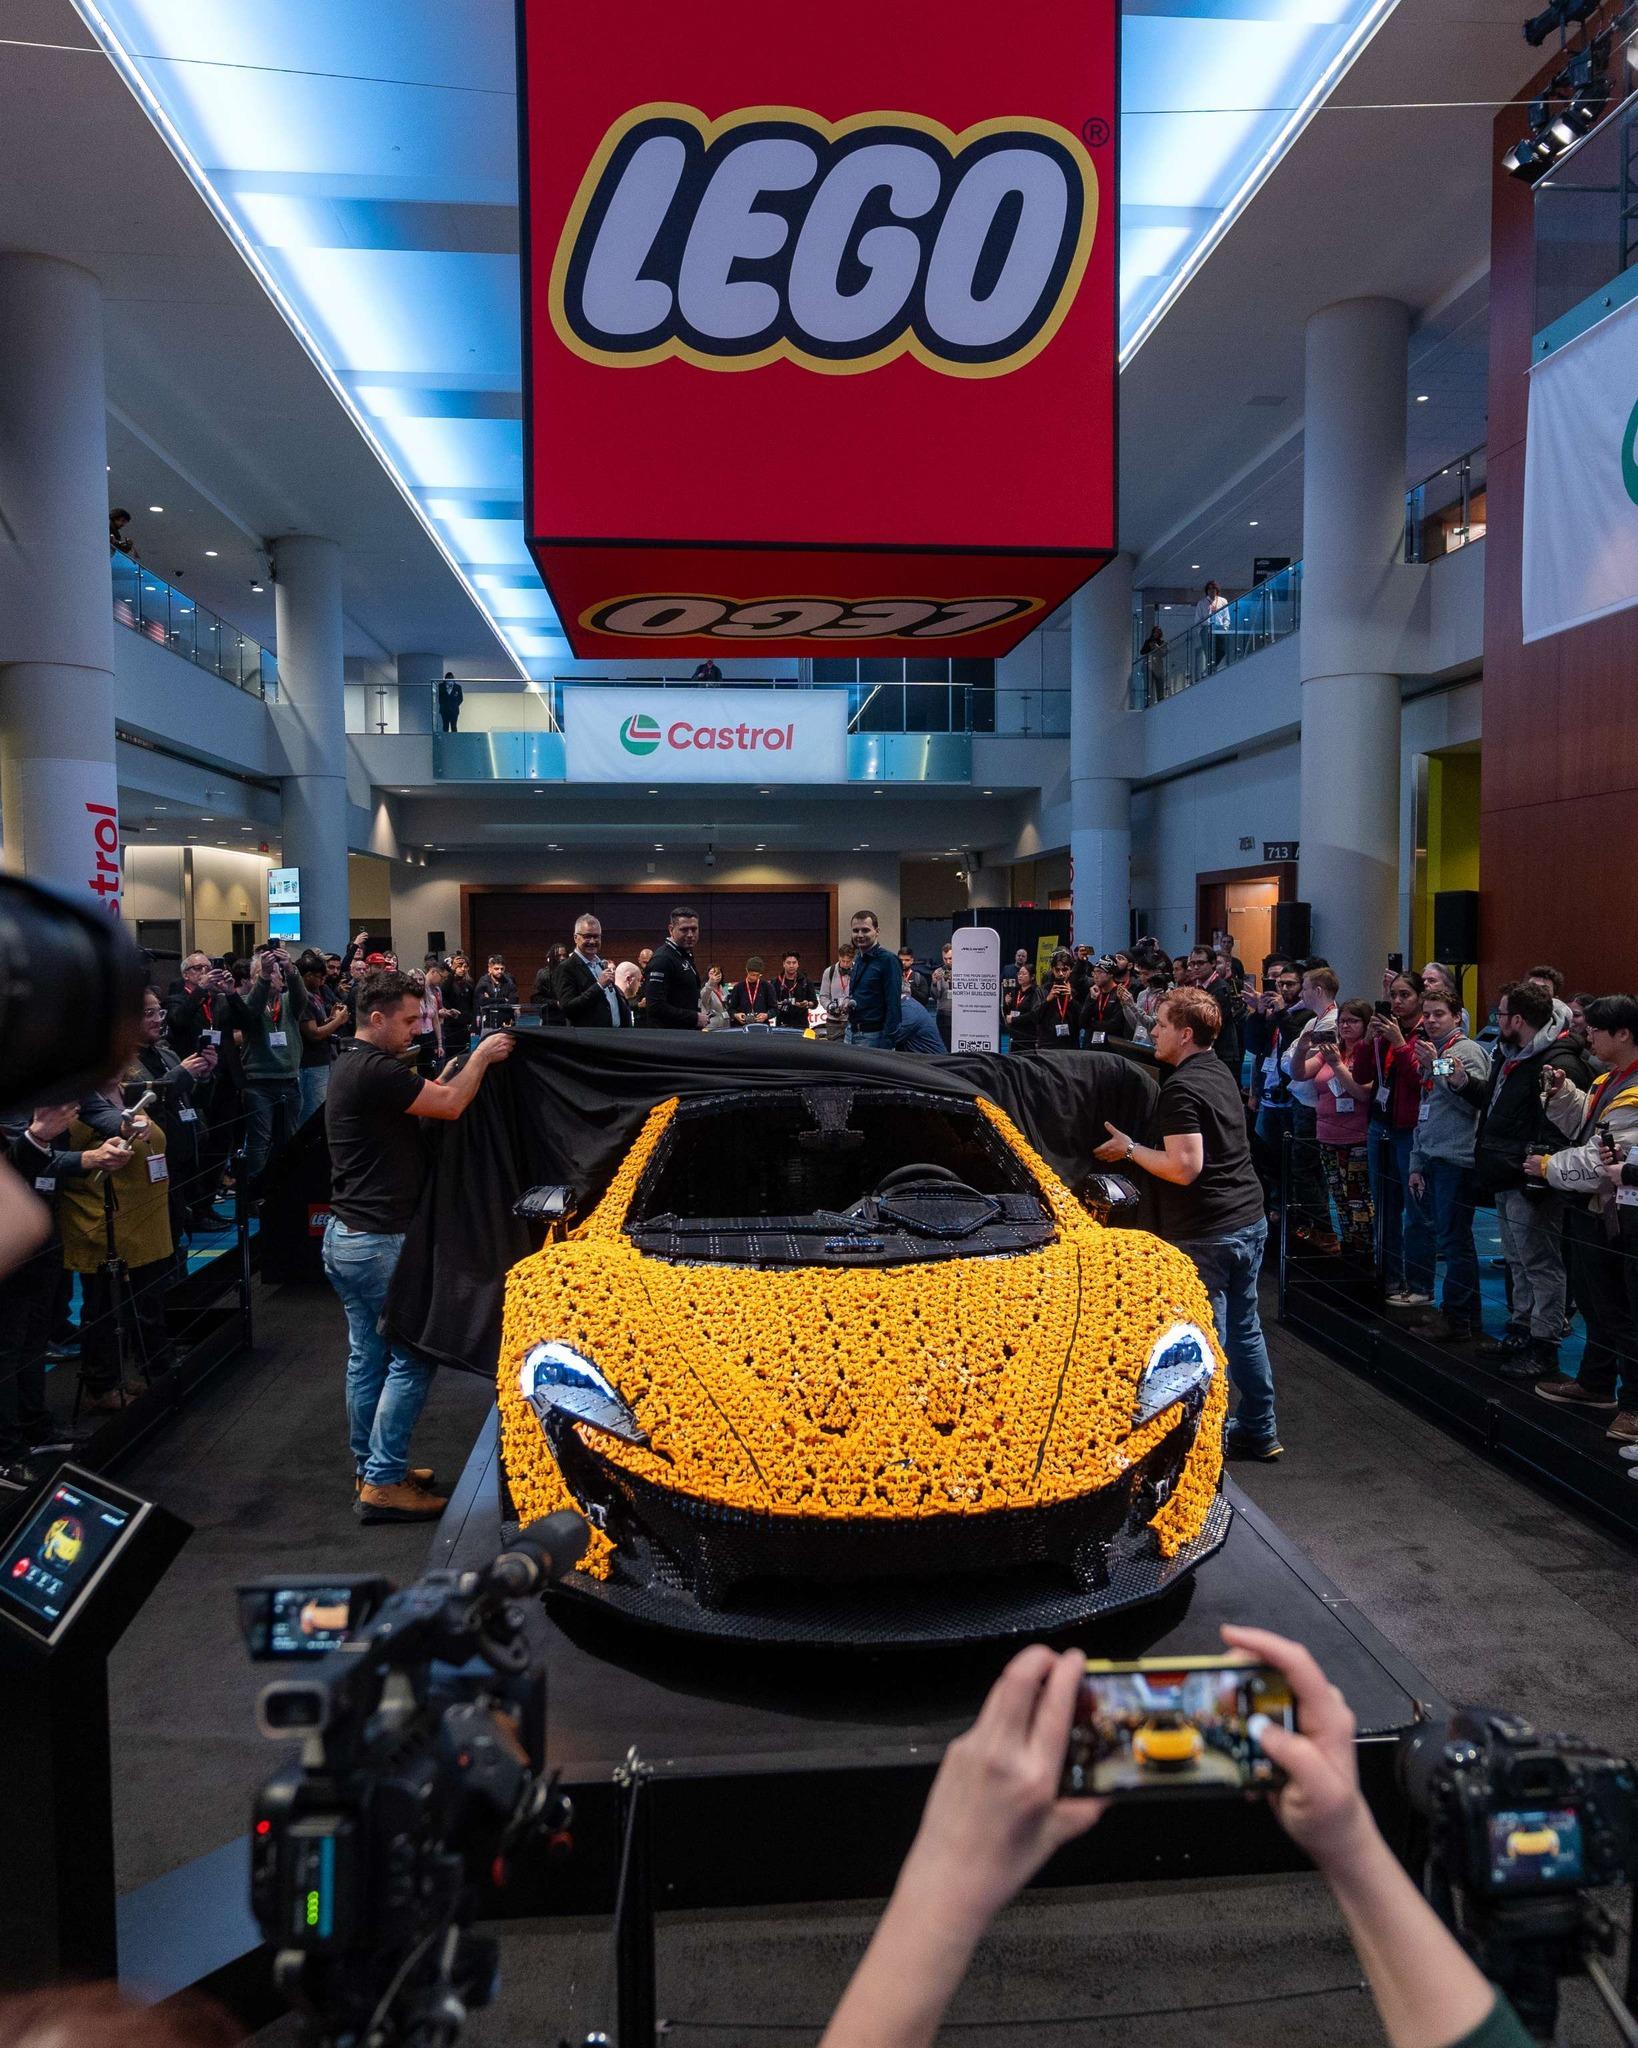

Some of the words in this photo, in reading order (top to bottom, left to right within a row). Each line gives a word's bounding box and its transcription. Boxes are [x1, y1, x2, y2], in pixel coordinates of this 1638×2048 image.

[581, 135, 1069, 347] LEGO
[604, 598, 1035, 637] LEGO
[667, 721, 795, 751] Castrol
[85, 802, 120, 920] strol
[1267, 847, 1289, 859] 713
[952, 982, 979, 990] LEVEL
[980, 982, 998, 991] 300
[1560, 1164, 1604, 1182] UTICA
[311, 1214, 331, 1226] LEG
